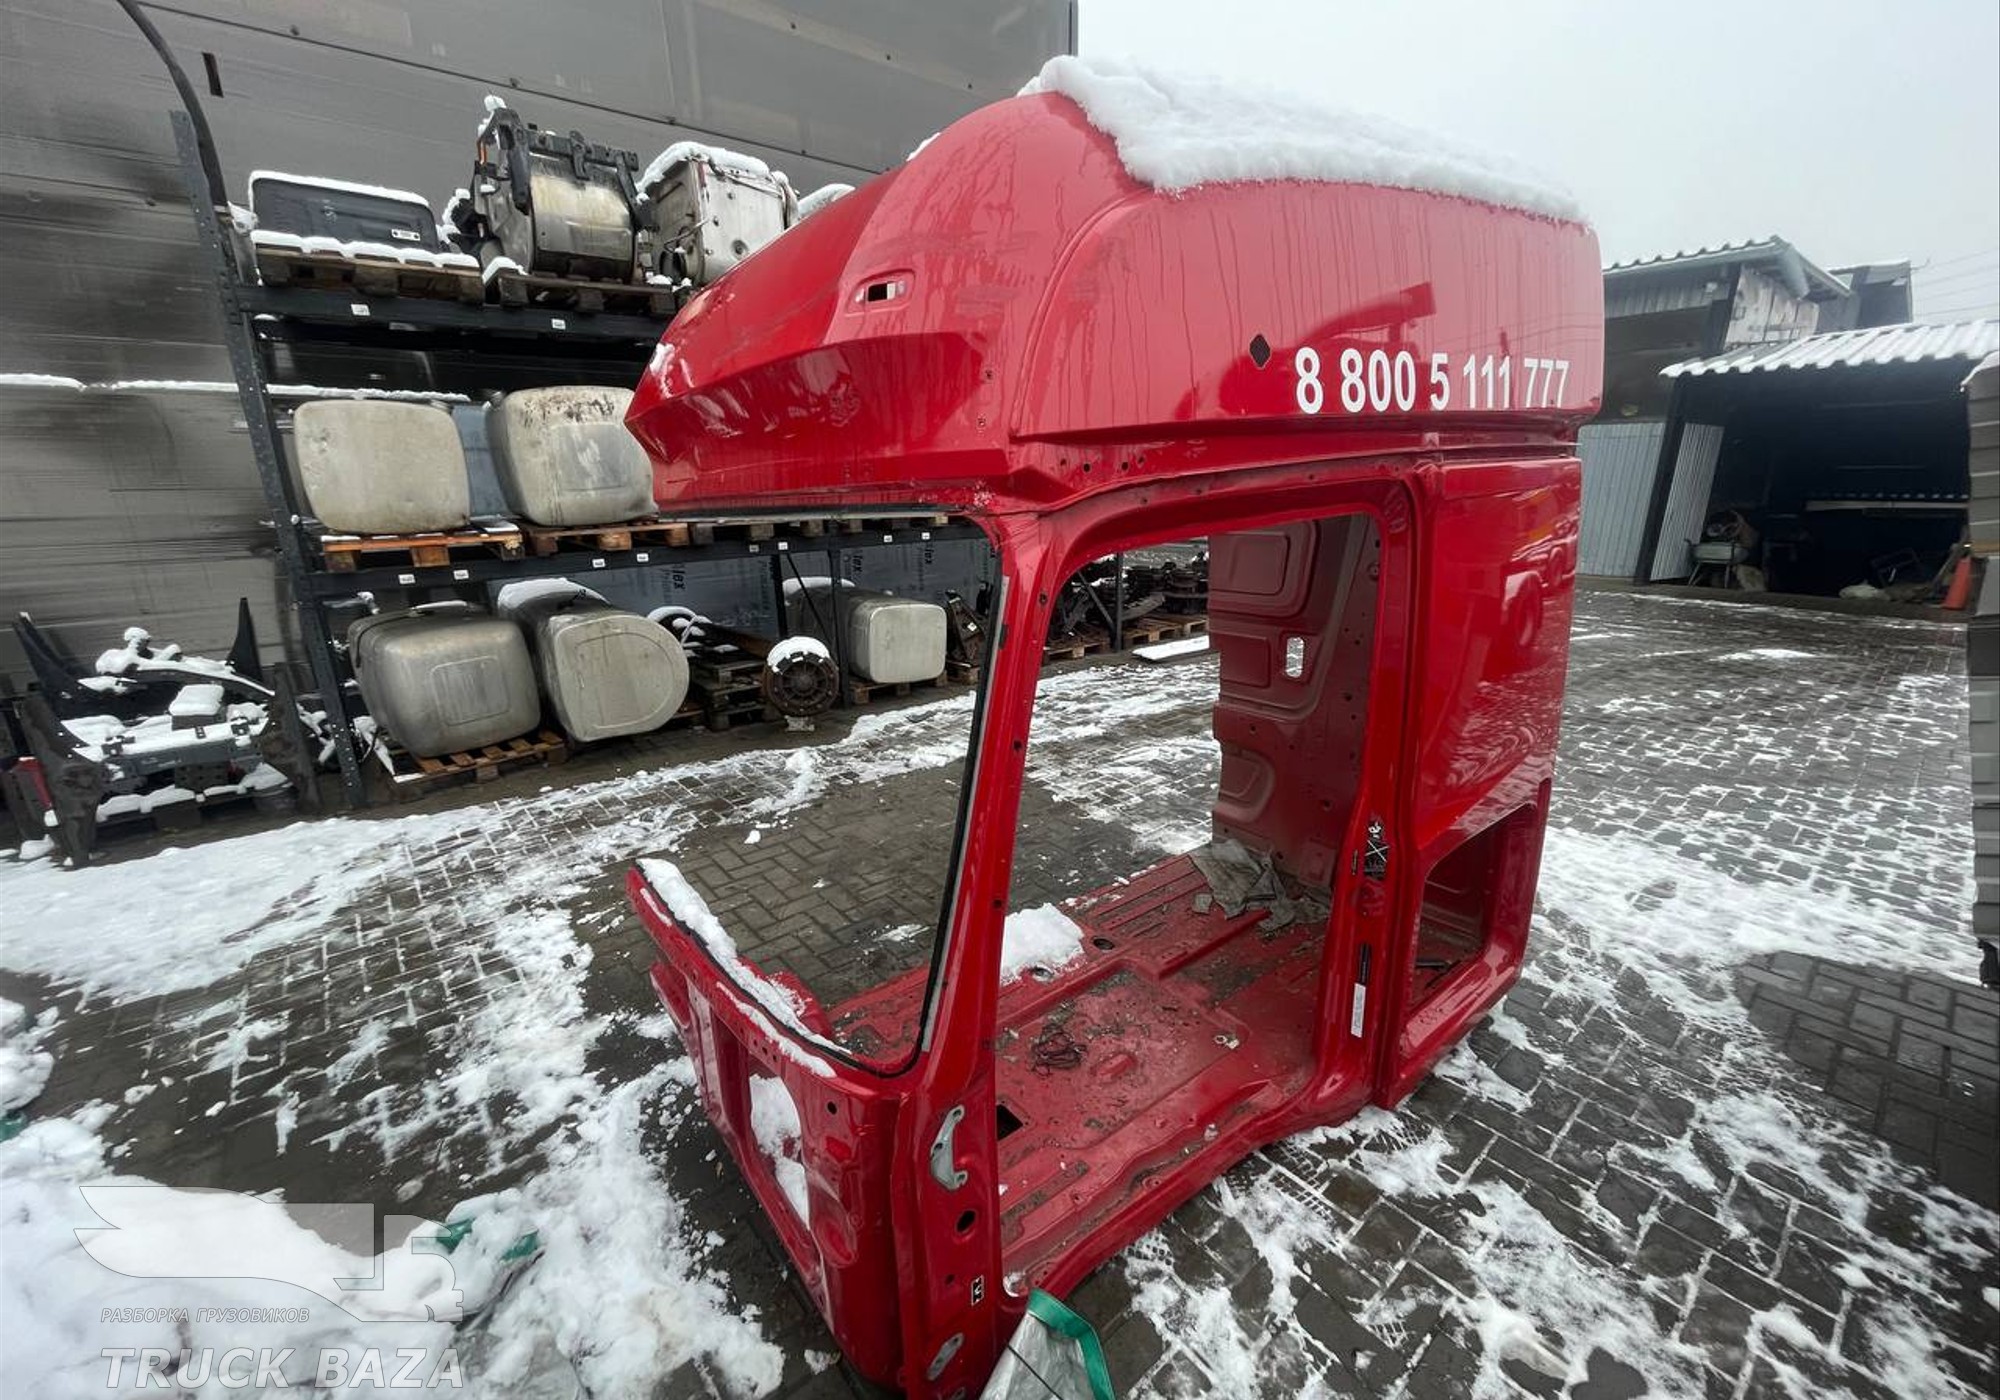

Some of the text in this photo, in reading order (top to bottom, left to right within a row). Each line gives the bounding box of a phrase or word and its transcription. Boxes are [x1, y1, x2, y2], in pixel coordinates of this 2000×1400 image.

[1295, 347, 1569, 414] 8 800 5 111 777
